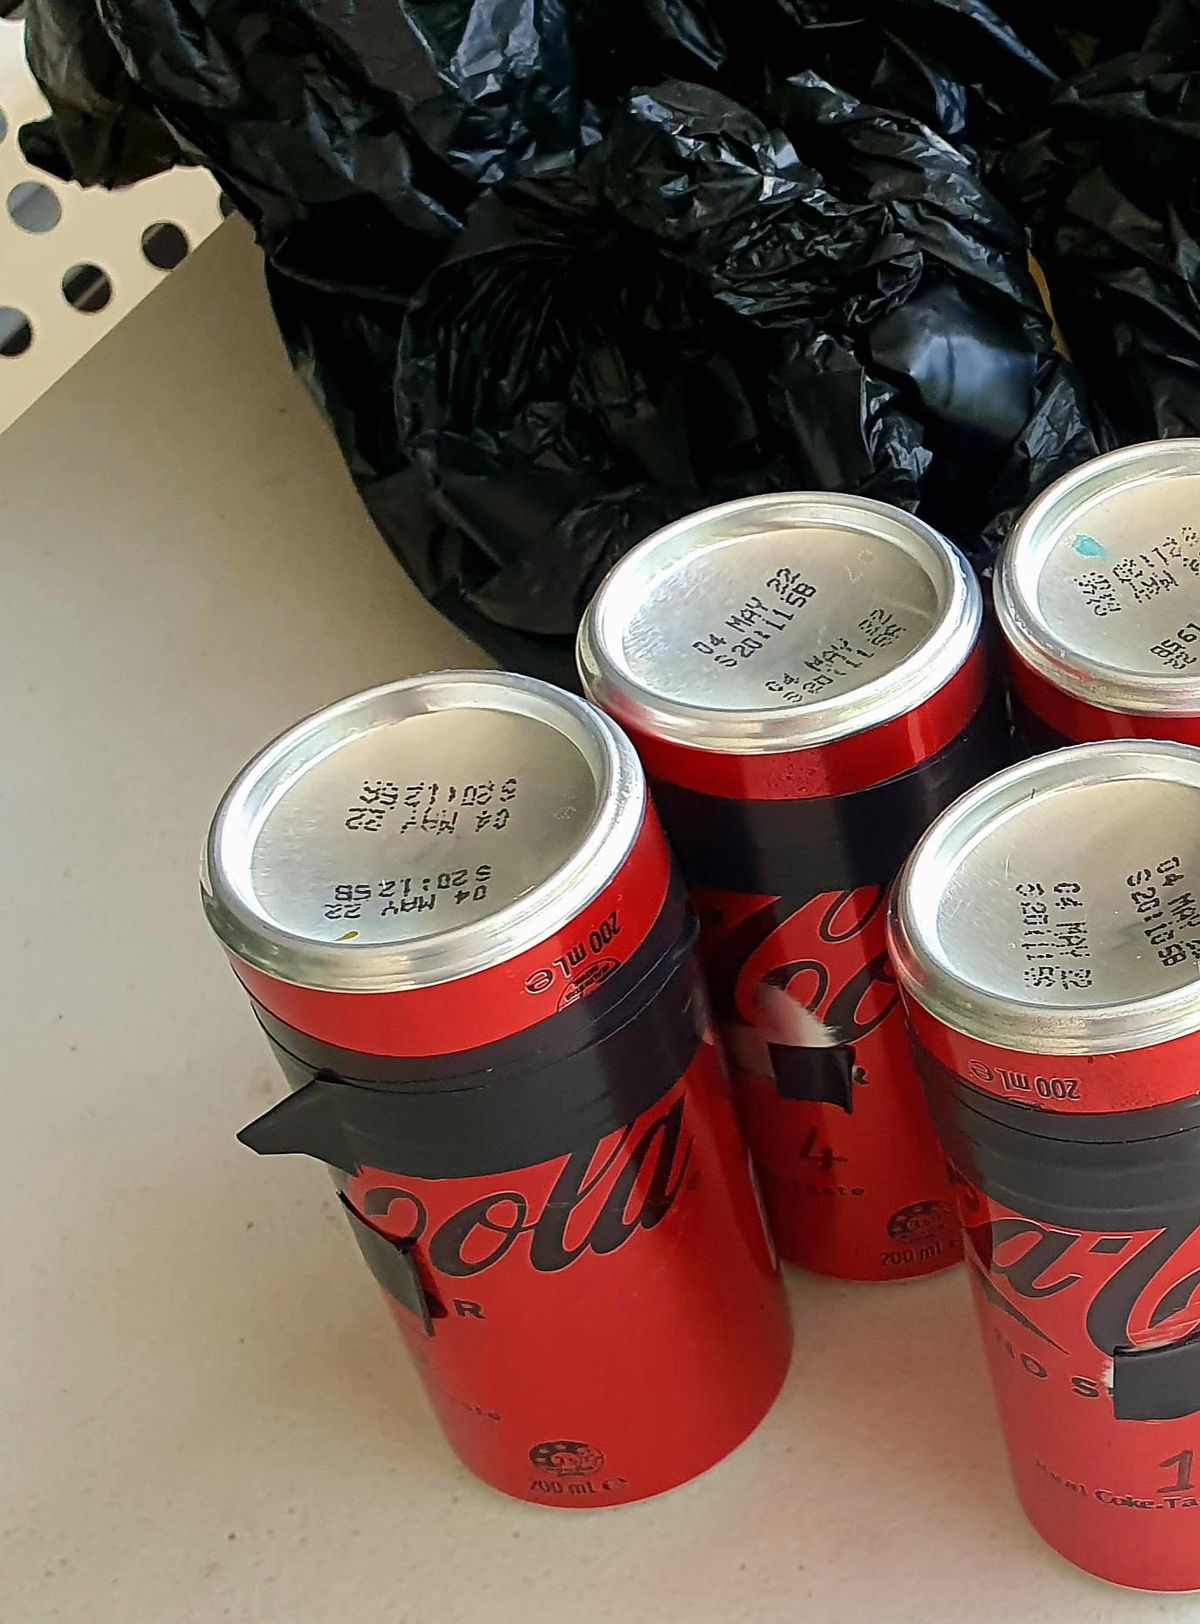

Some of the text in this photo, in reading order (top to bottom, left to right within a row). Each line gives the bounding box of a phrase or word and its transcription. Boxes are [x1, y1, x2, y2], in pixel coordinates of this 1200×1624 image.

[692, 633, 727, 655] 04
[725, 596, 771, 633] MAY
[1155, 855, 1186, 888] 04
[324, 885, 488, 920] 04 MAY 22
[587, 910, 624, 954] 200
[1050, 920, 1091, 959] MAY
[1036, 1074, 1081, 1101] 200
[800, 1125, 849, 1171] 4
[1156, 1450, 1196, 1493] 1
